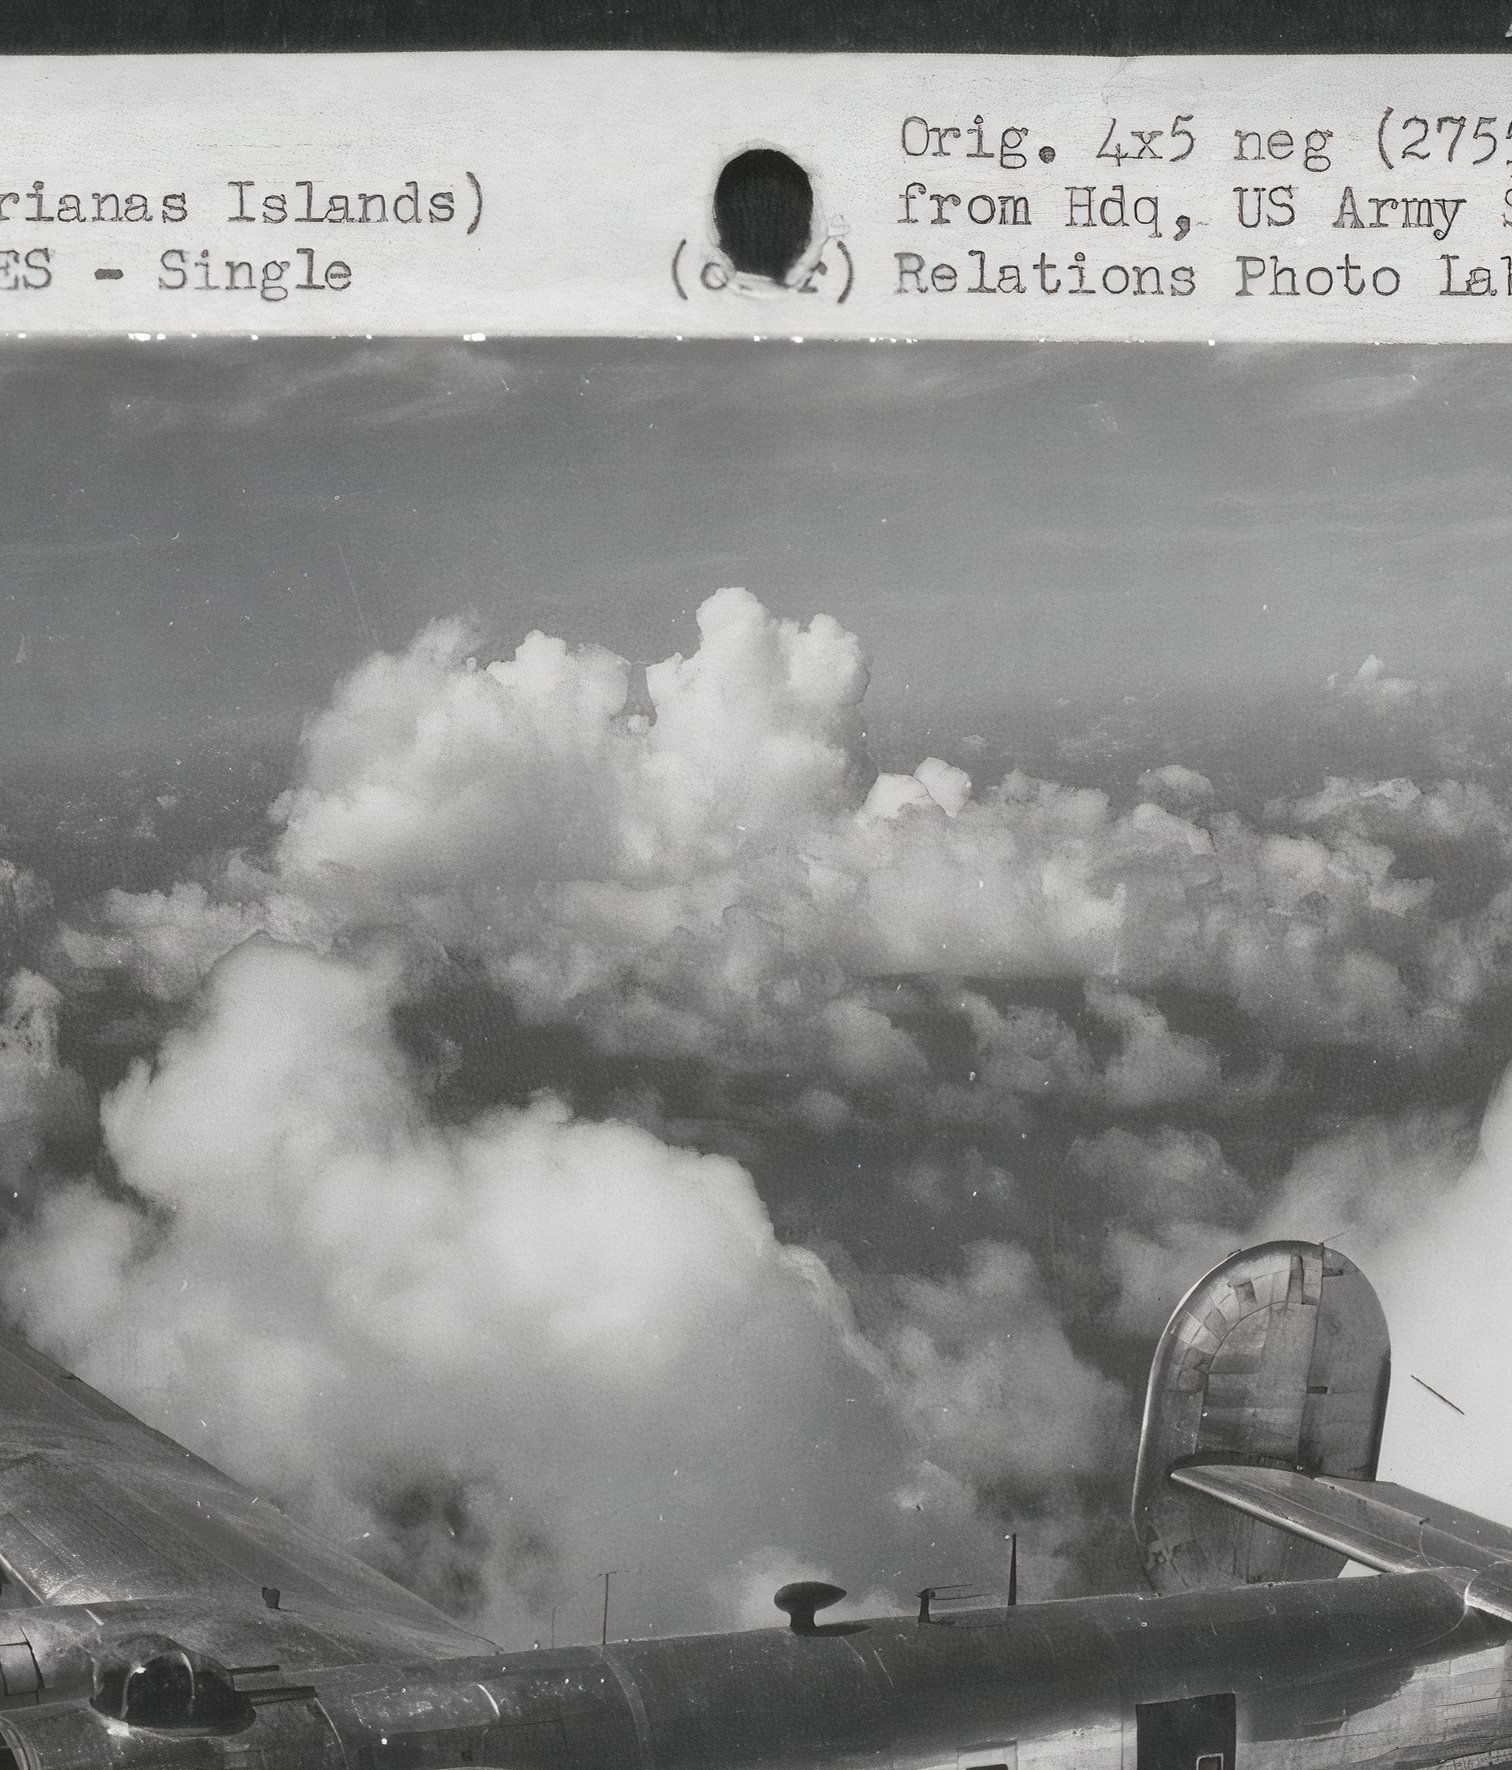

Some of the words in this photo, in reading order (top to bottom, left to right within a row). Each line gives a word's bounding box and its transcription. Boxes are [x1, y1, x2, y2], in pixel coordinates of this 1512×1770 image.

[901, 114, 1060, 170] Orig.
[1096, 114, 1196, 167] 4x5
[1234, 128, 1333, 172] neg
[228, 174, 488, 235] Islands)
[897, 182, 1033, 226] from
[1065, 184, 1196, 242] Hdq,
[1233, 185, 1298, 230] US
[1331, 185, 1467, 242] Army
[158, 247, 354, 303] Single
[672, 239, 854, 303] (or)
[894, 249, 1198, 297] Relations
[1235, 252, 1402, 297] Photo
